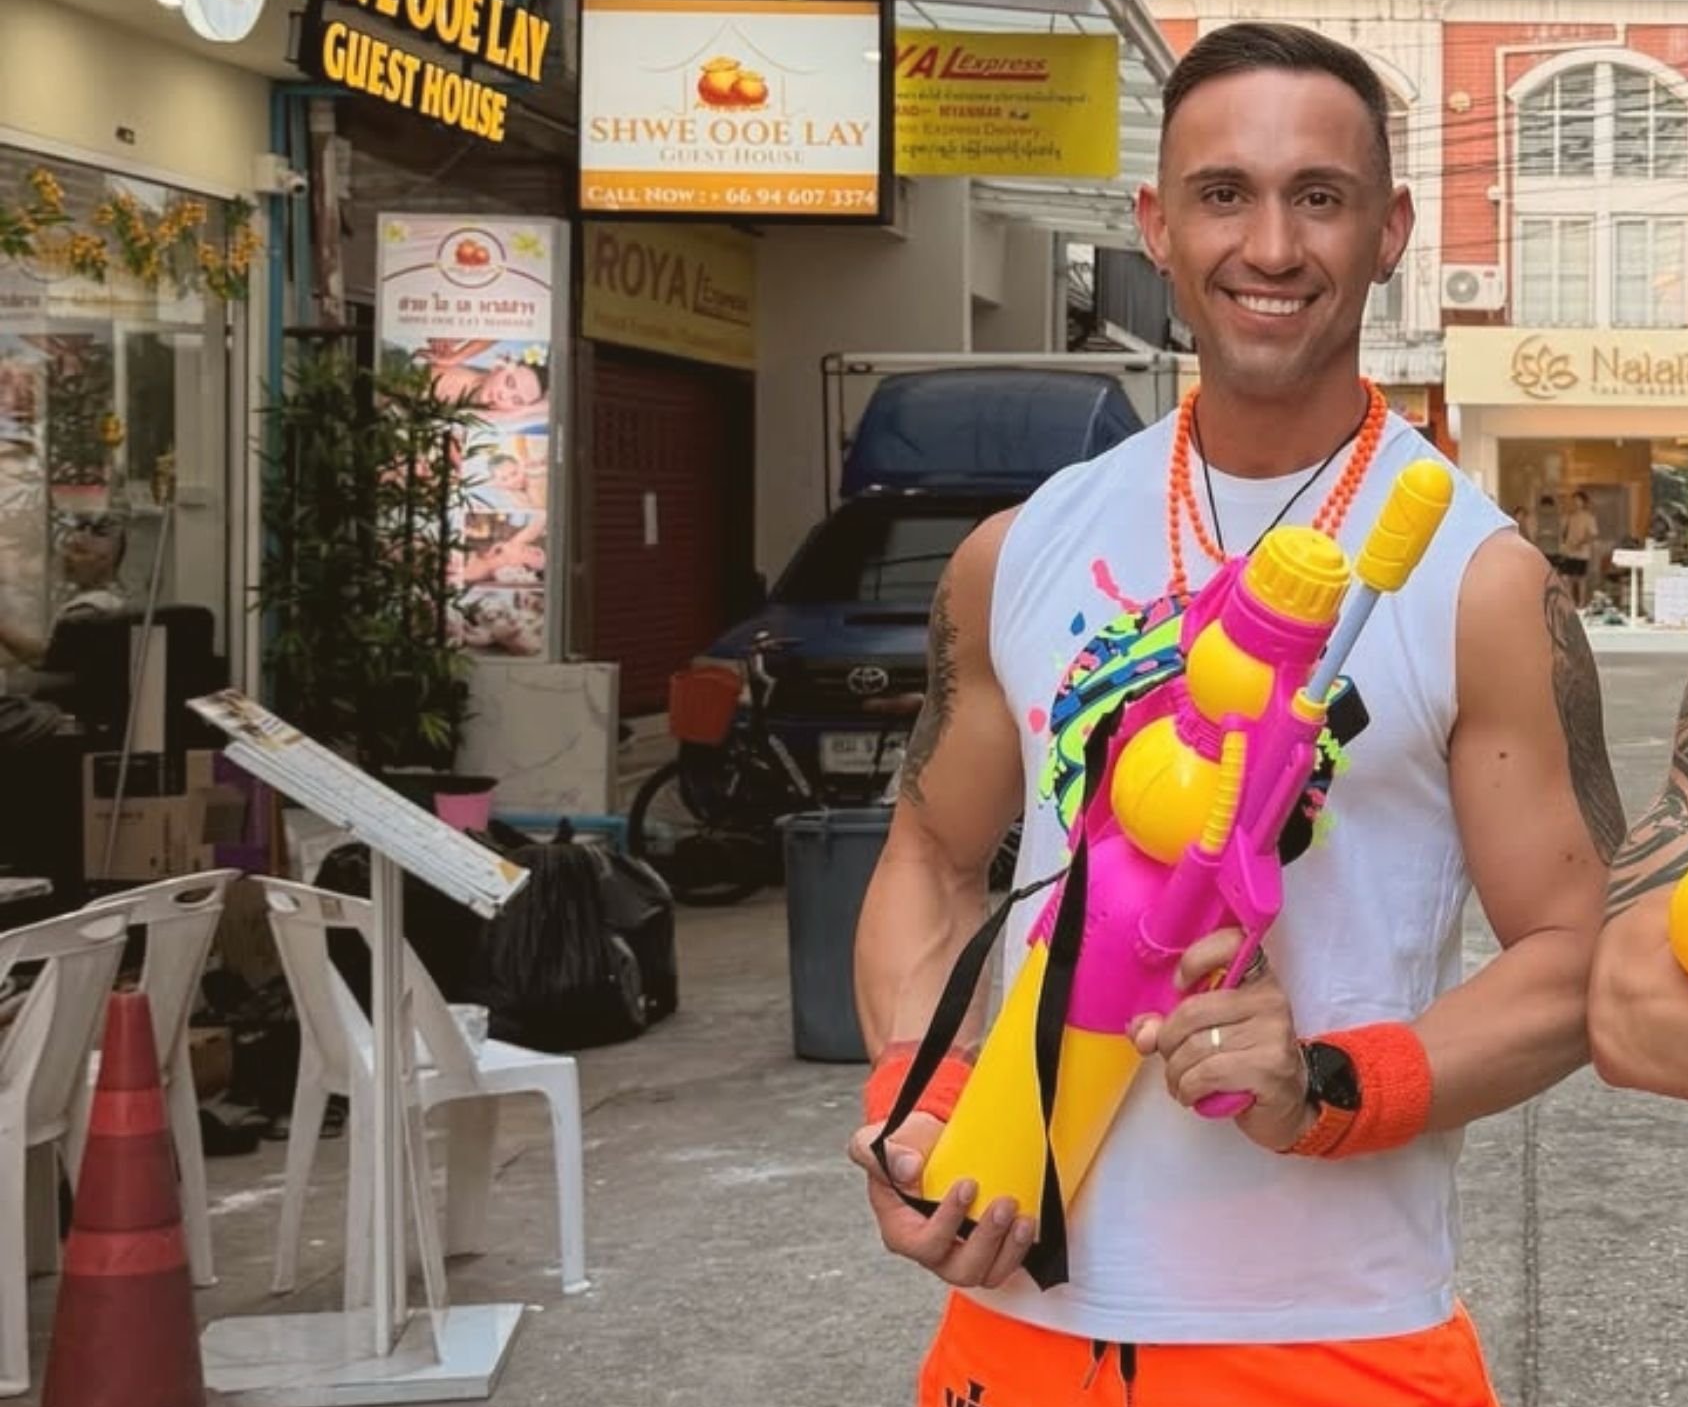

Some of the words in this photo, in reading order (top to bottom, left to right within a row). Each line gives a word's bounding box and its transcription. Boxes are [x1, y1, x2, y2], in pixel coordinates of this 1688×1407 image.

[957, 54, 1048, 74] Express
[323, 21, 421, 107] GUEST
[420, 62, 508, 143] HOUSE
[589, 117, 697, 143] SHWE
[709, 119, 792, 145] OOE
[804, 121, 870, 147] LAY
[588, 185, 639, 203] CALL
[594, 232, 712, 314] ROYAL
